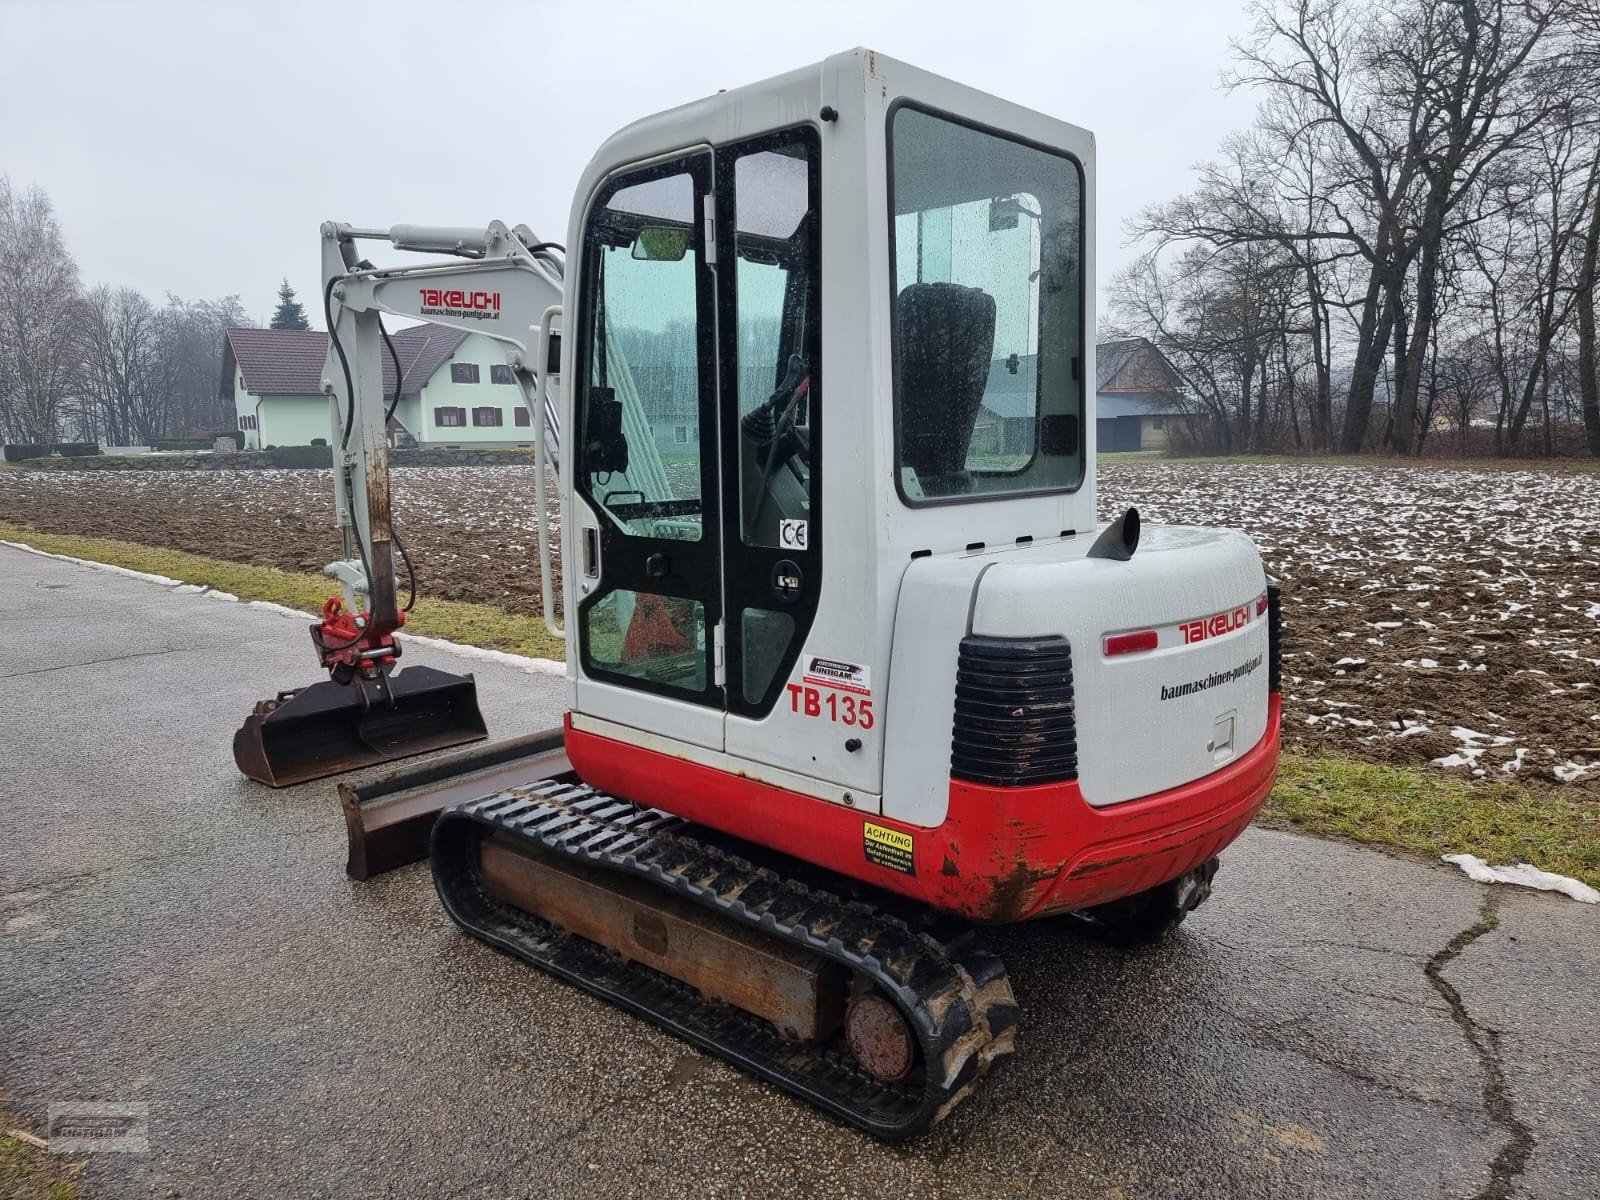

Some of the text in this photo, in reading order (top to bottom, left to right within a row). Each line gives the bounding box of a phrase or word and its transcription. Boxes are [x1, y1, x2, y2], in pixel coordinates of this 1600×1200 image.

[420, 289, 501, 310] TAKEUCHI
[782, 522, 805, 546] CE
[1178, 605, 1251, 645] TAKEUCHI
[866, 826, 911, 848] ACHTUNG
